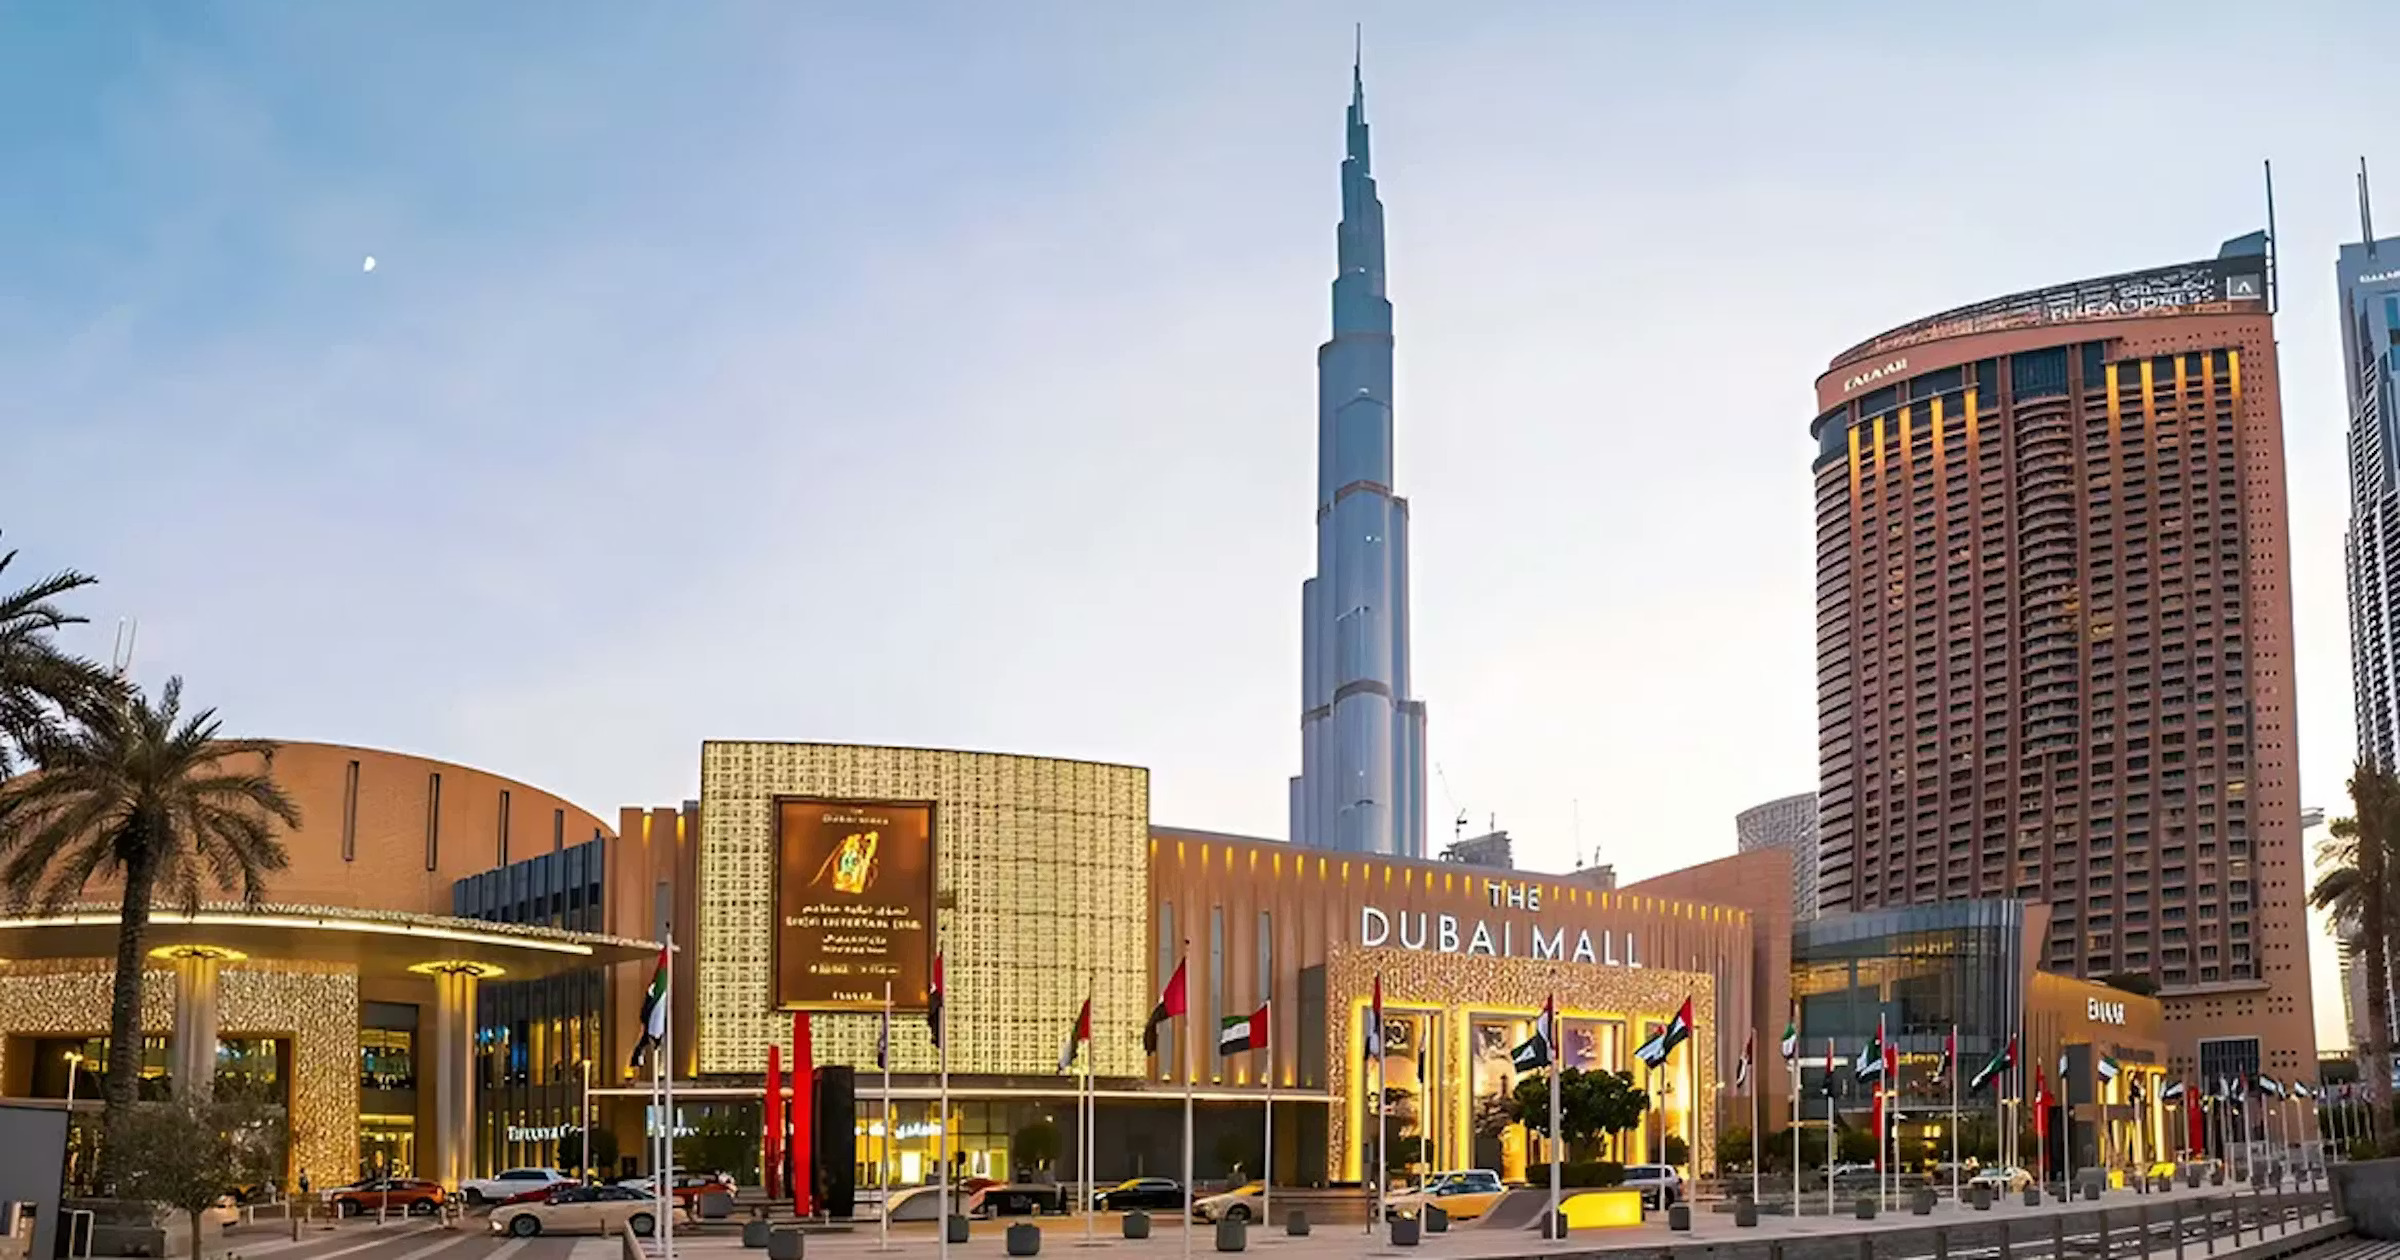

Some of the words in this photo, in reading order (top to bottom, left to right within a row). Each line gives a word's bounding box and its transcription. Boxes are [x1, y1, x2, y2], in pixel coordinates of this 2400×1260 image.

[1487, 882, 1541, 912] THE
[1361, 905, 1511, 957] DUBAI
[1532, 924, 1643, 969] MALL
